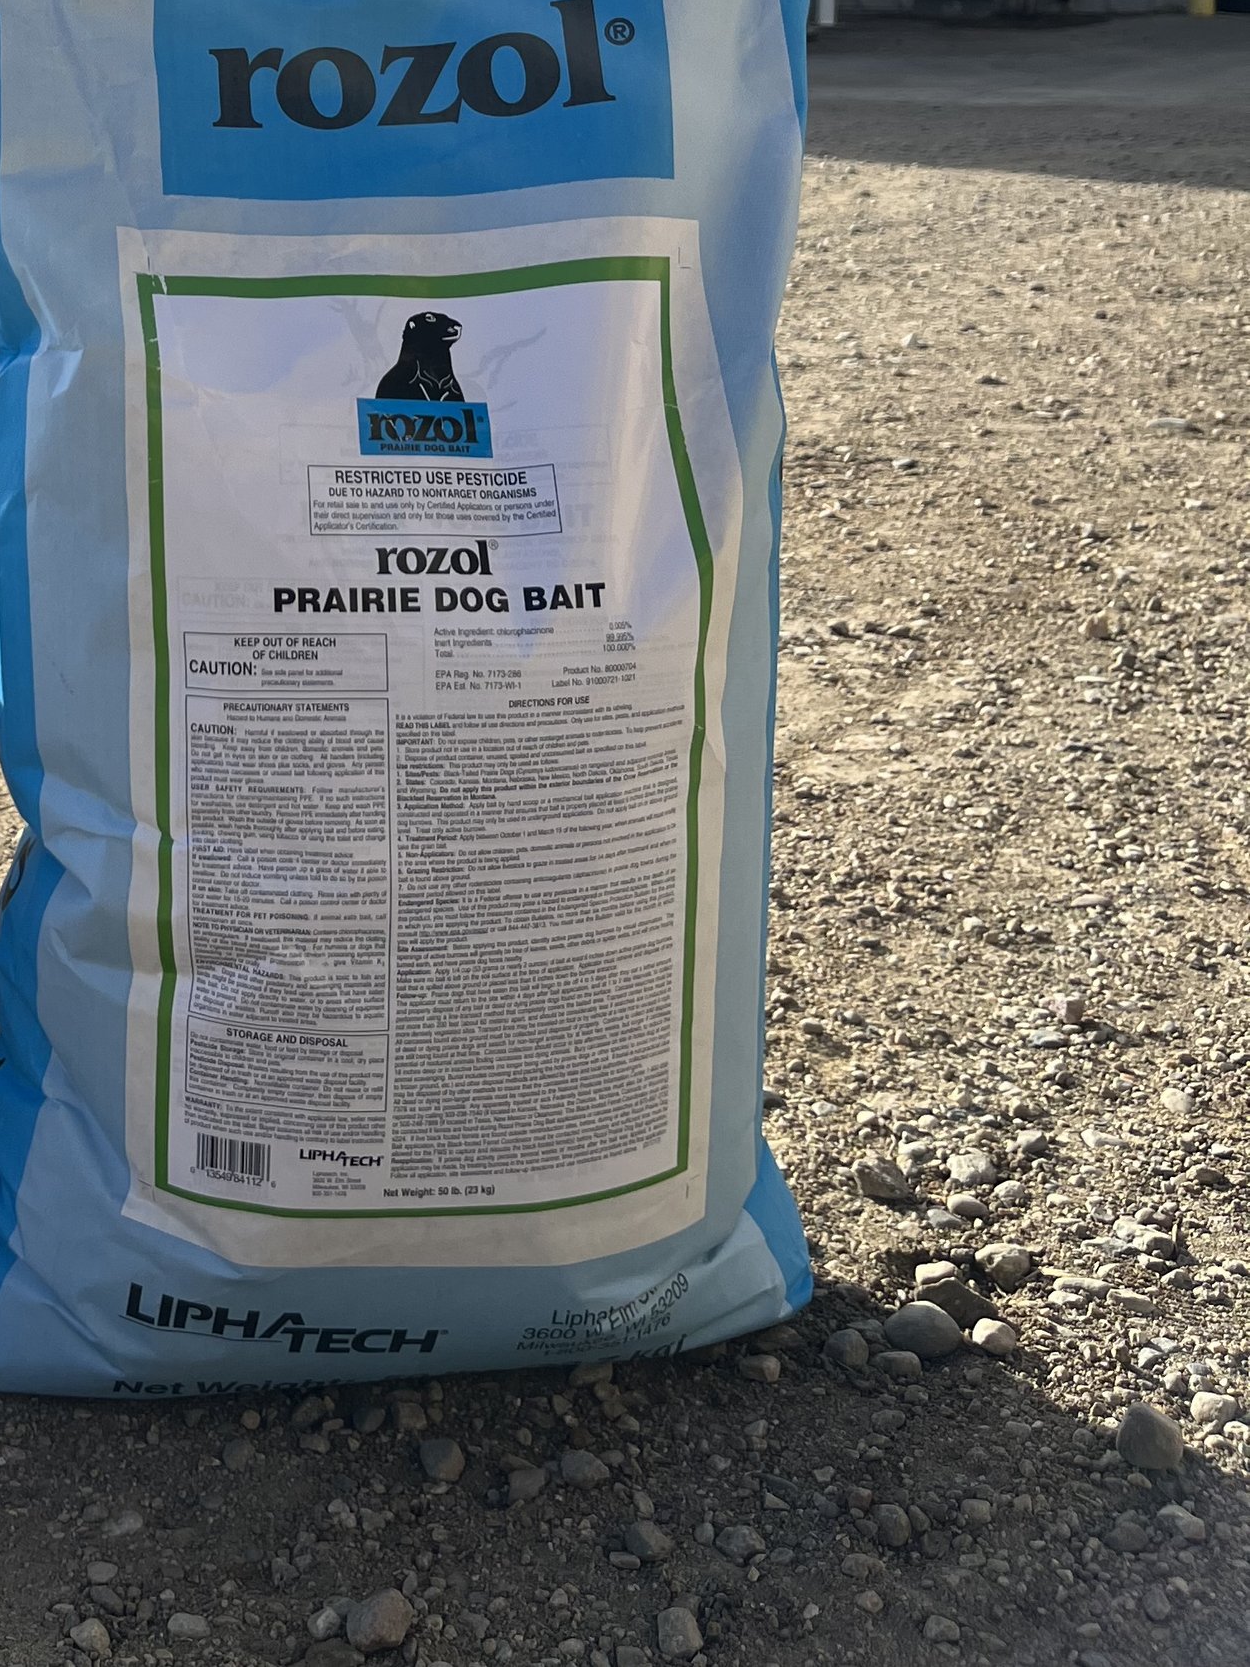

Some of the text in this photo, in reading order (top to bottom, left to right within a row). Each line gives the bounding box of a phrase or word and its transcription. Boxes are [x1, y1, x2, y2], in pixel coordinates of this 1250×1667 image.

[380, 443, 470, 453] PRAIRIE DOG BAIT
[334, 470, 527, 486] RESTRICTED USE PESTICIDE
[328, 487, 537, 499] DUE TO HAZARD TO NONTARGET ORGANISMS
[312, 499, 325, 508] For
[326, 500, 344, 508] retail
[345, 501, 360, 509] sale
[360, 501, 369, 509] to
[369, 501, 384, 509] and
[385, 502, 399, 510] use
[398, 500, 415, 510] only
[415, 501, 425, 511] by
[426, 500, 456, 510] Certified
[502, 501, 532, 513] persons
[533, 499, 556, 509] under
[313, 510, 329, 519] their
[330, 511, 350, 519] direct
[351, 512, 392, 520] supervision
[392, 511, 407, 520] and
[407, 512, 423, 521] only
[423, 511, 434, 519] for
[435, 512, 455, 521] those
[472, 513, 501, 522] covered
[500, 512, 511, 523] by
[512, 512, 525, 521] the
[525, 508, 557, 518] Certified
[273, 582, 606, 613] PRAIRIE DOG BAIT
[433, 627, 456, 636] Active
[233, 636, 336, 647] KEEP OUT OF REACH
[252, 649, 318, 660] OF CHILDREN
[189, 659, 257, 676] CAUTION:
[434, 669, 452, 678] EPA
[562, 665, 589, 675] Product
[435, 681, 452, 690] EPA
[550, 678, 571, 688] Label
[222, 702, 350, 712] PRECAUTIONARY STATEMENTS
[508, 695, 590, 708] DIRECTIONS FOR USE
[190, 722, 237, 735] CAUTION:
[225, 1027, 348, 1048] STORAGE AND DISPOSAL
[299, 1149, 381, 1167] LIPHATECH
[205, 1169, 231, 1182] 13549
[383, 1184, 495, 1199] Net Weight: 50 lb. (23 kg)
[650, 1272, 689, 1320] 53209
[126, 1282, 440, 1353] LIPHATECH
[523, 1327, 576, 1339] 3600
[610, 1301, 639, 1330] Elm
[113, 1380, 182, 1395] Net
